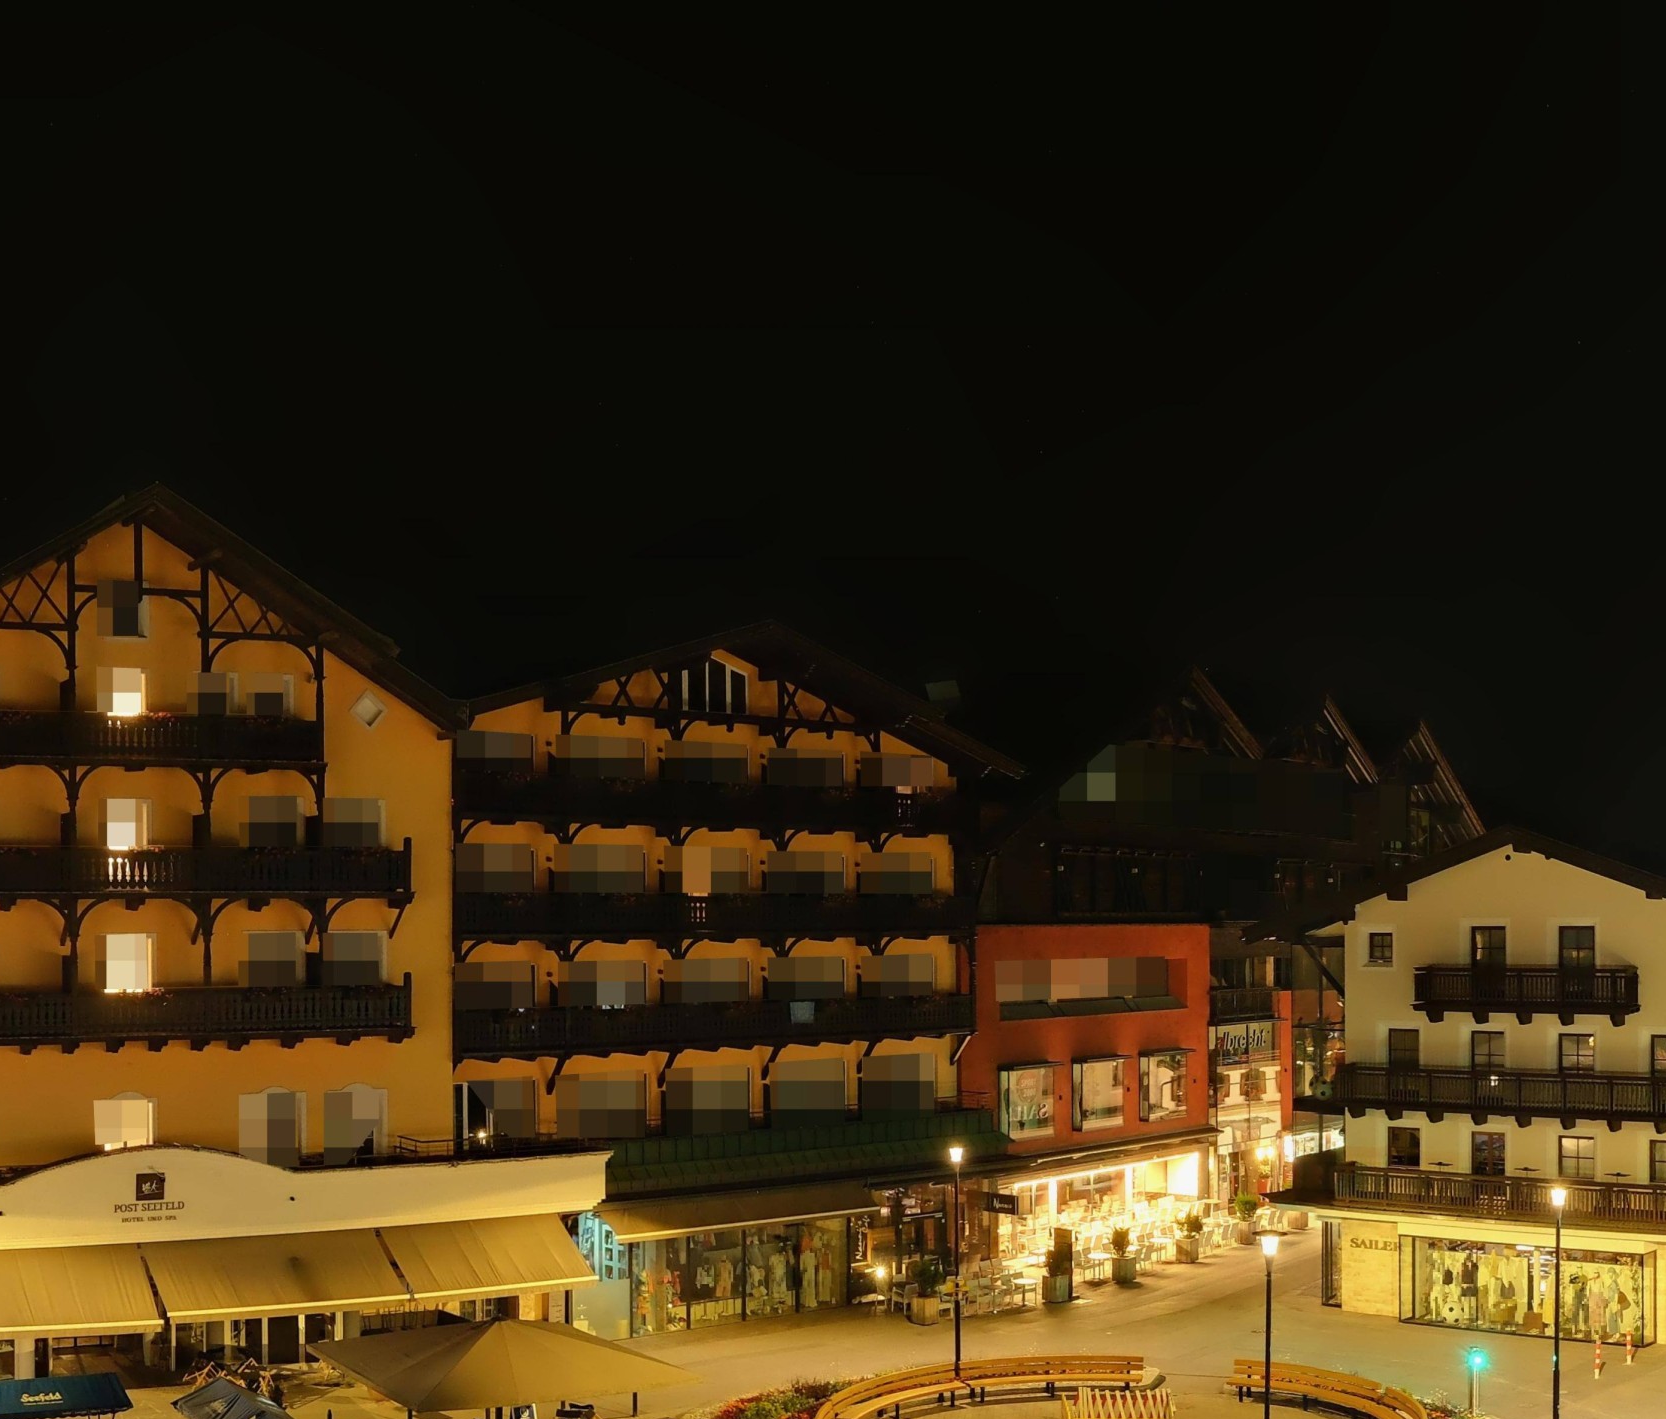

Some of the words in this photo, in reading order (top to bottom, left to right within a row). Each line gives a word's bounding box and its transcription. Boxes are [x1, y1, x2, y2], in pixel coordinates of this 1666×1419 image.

[114, 1204, 139, 1213] POST
[140, 1201, 185, 1212] SEEFELD
[21, 1391, 62, 1402] Seefeld
